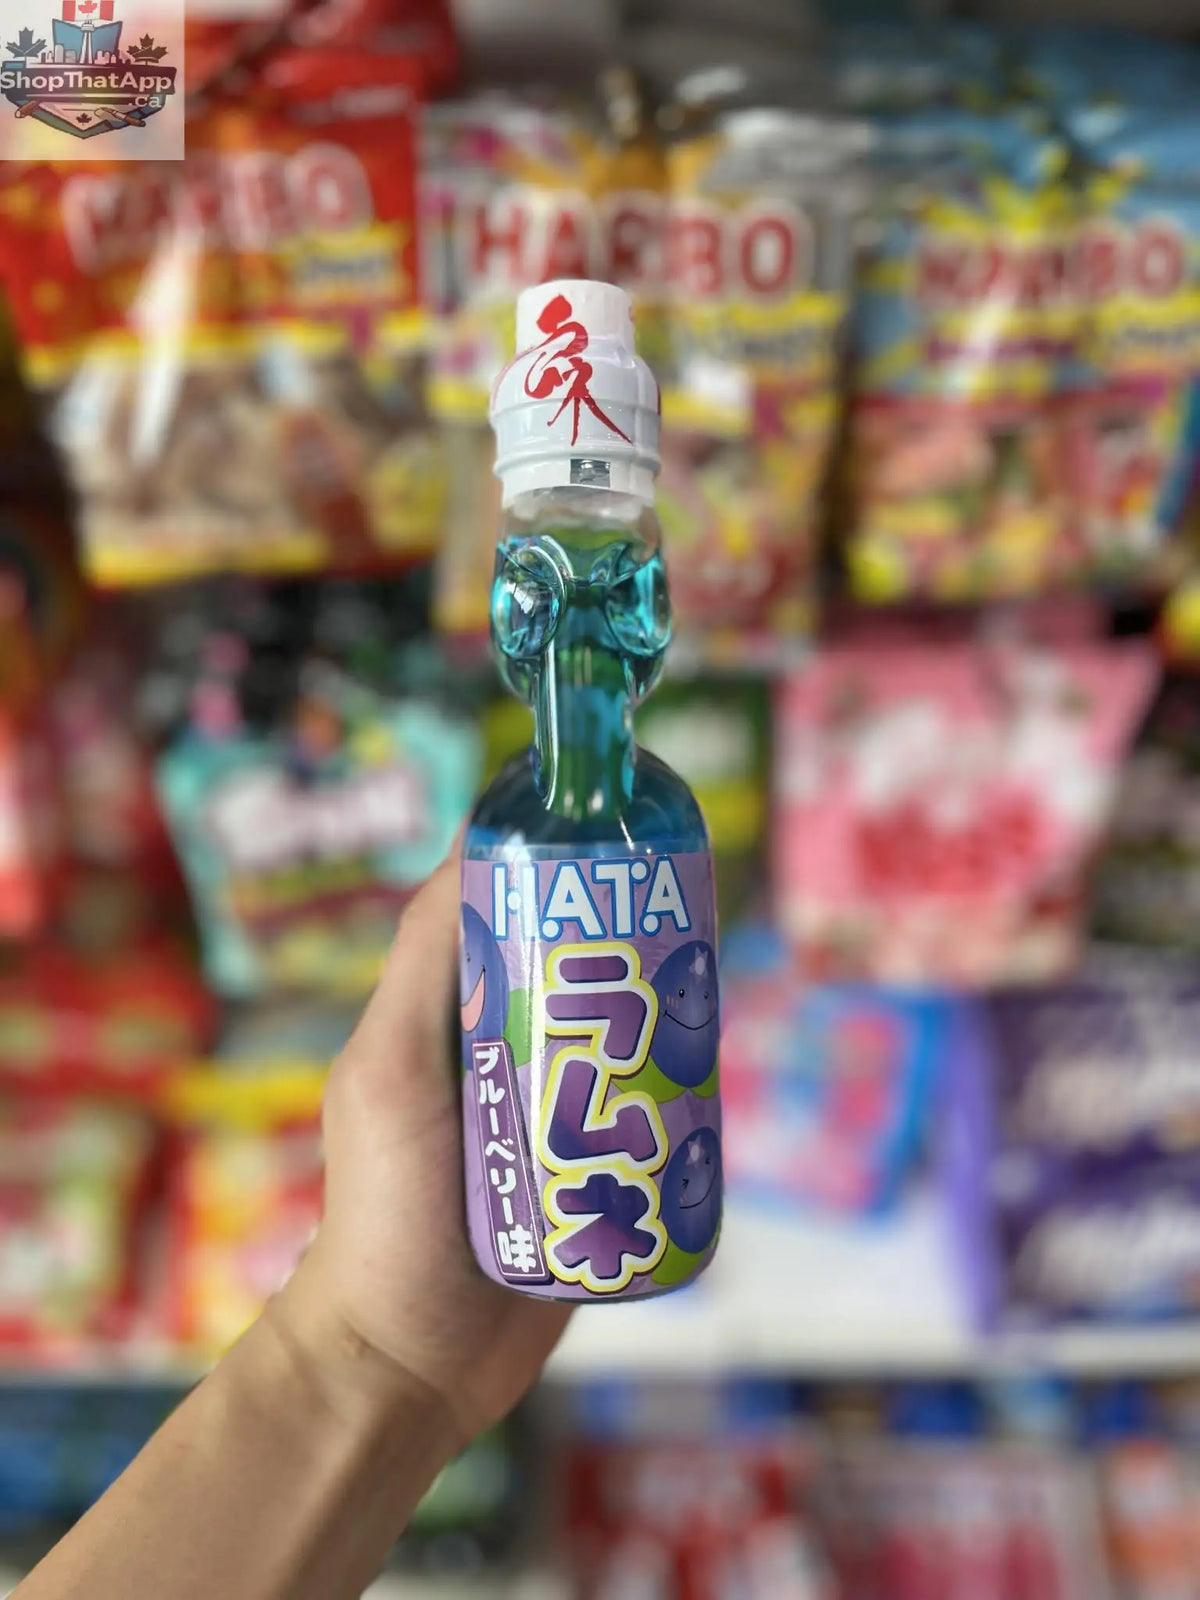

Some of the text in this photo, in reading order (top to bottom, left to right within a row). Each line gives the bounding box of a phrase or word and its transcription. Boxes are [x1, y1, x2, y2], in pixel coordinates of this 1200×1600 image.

[491, 856, 691, 941] HATA
[475, 1047, 537, 1273] ブルーベリー味
[540, 943, 668, 1294] ラムネ
